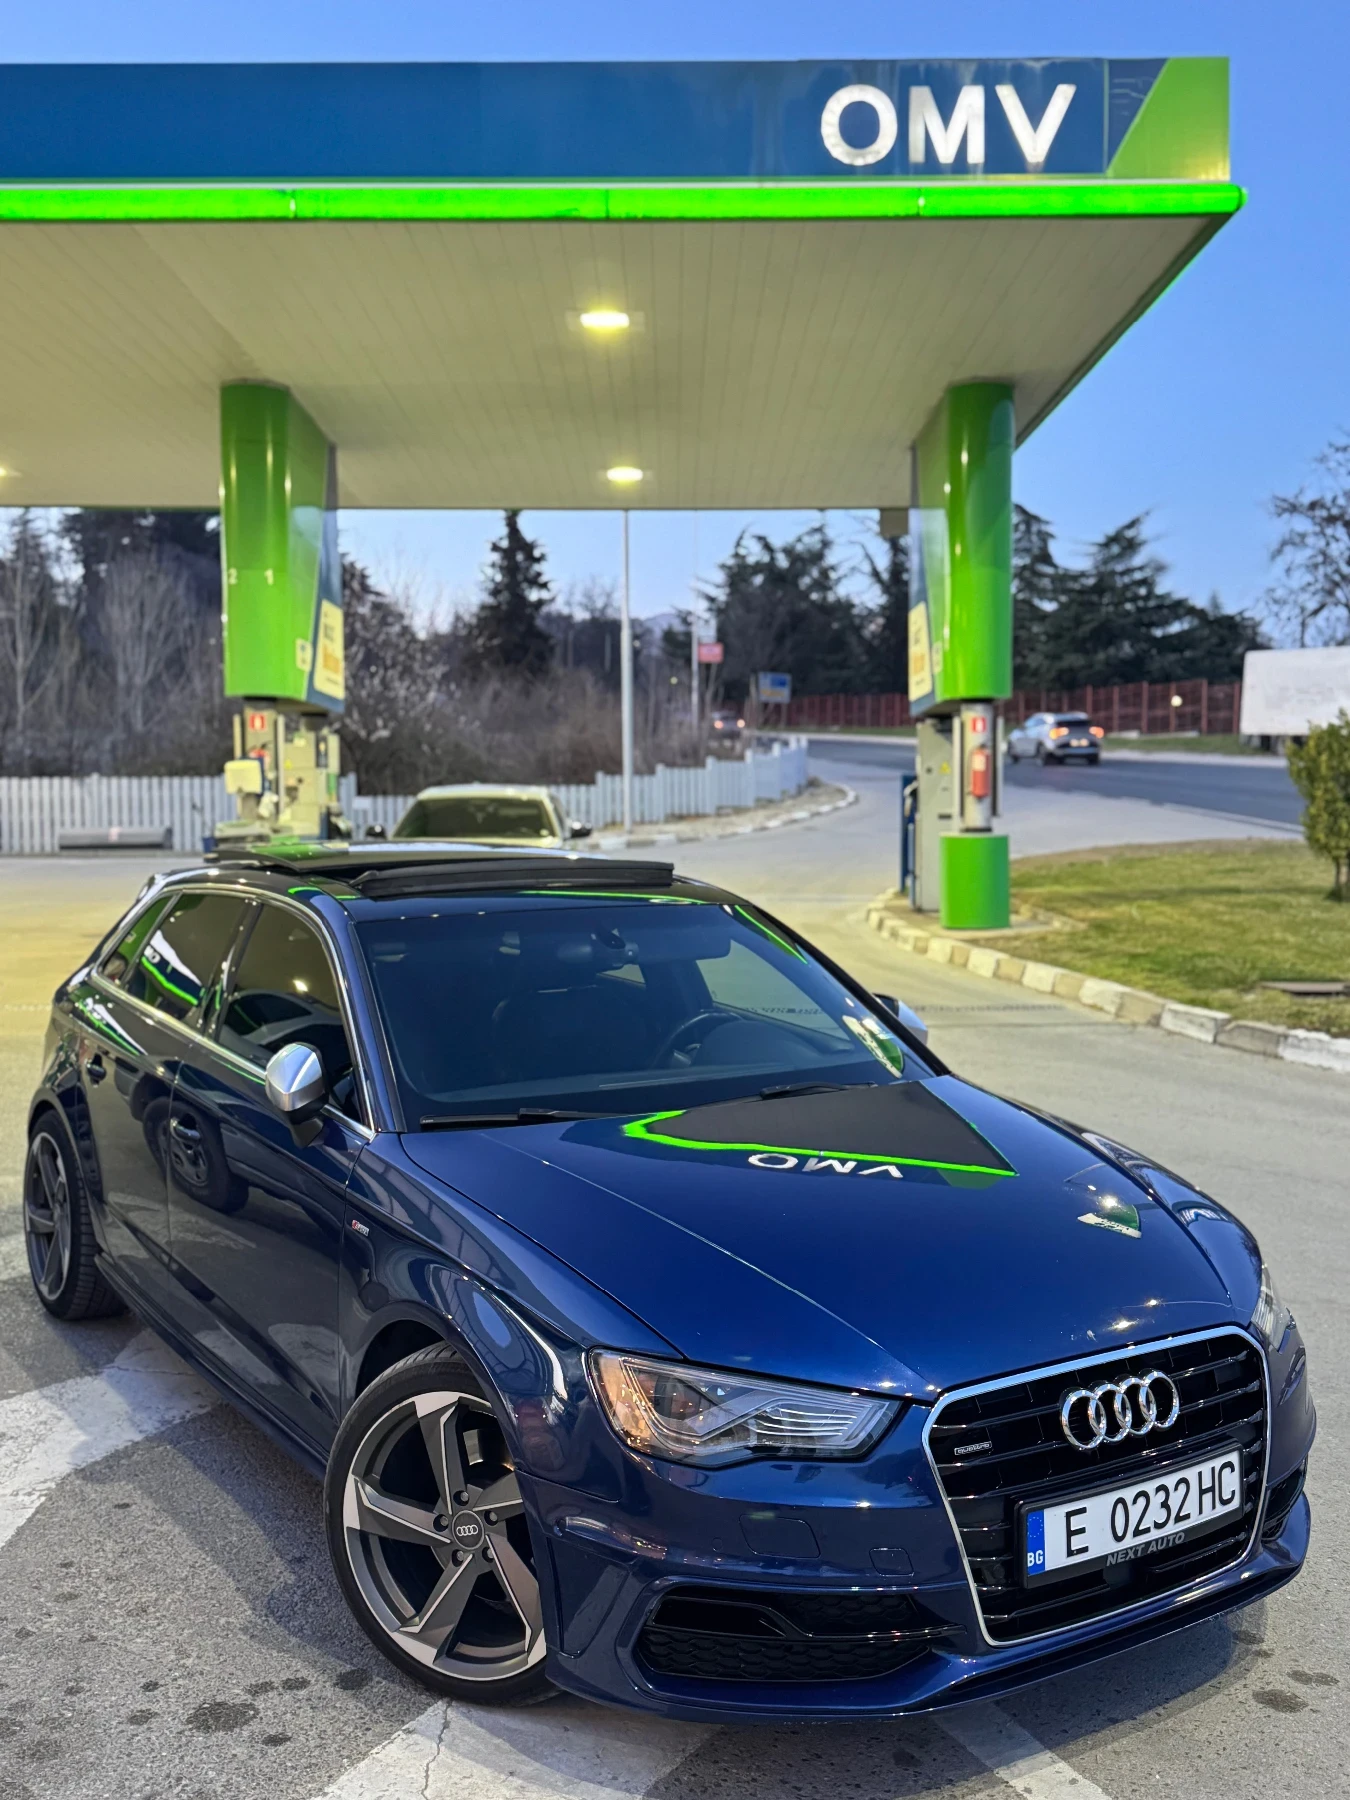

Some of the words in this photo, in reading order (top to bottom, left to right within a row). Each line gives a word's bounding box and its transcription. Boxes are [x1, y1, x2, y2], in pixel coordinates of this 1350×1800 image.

[820, 83, 1077, 167] OMV
[1065, 1506, 1089, 1558] E
[1110, 1476, 1191, 1544] 0232
[1027, 1549, 1044, 1568] BG
[1106, 1544, 1145, 1567] NEXT
[1147, 1532, 1185, 1554] AUTO
